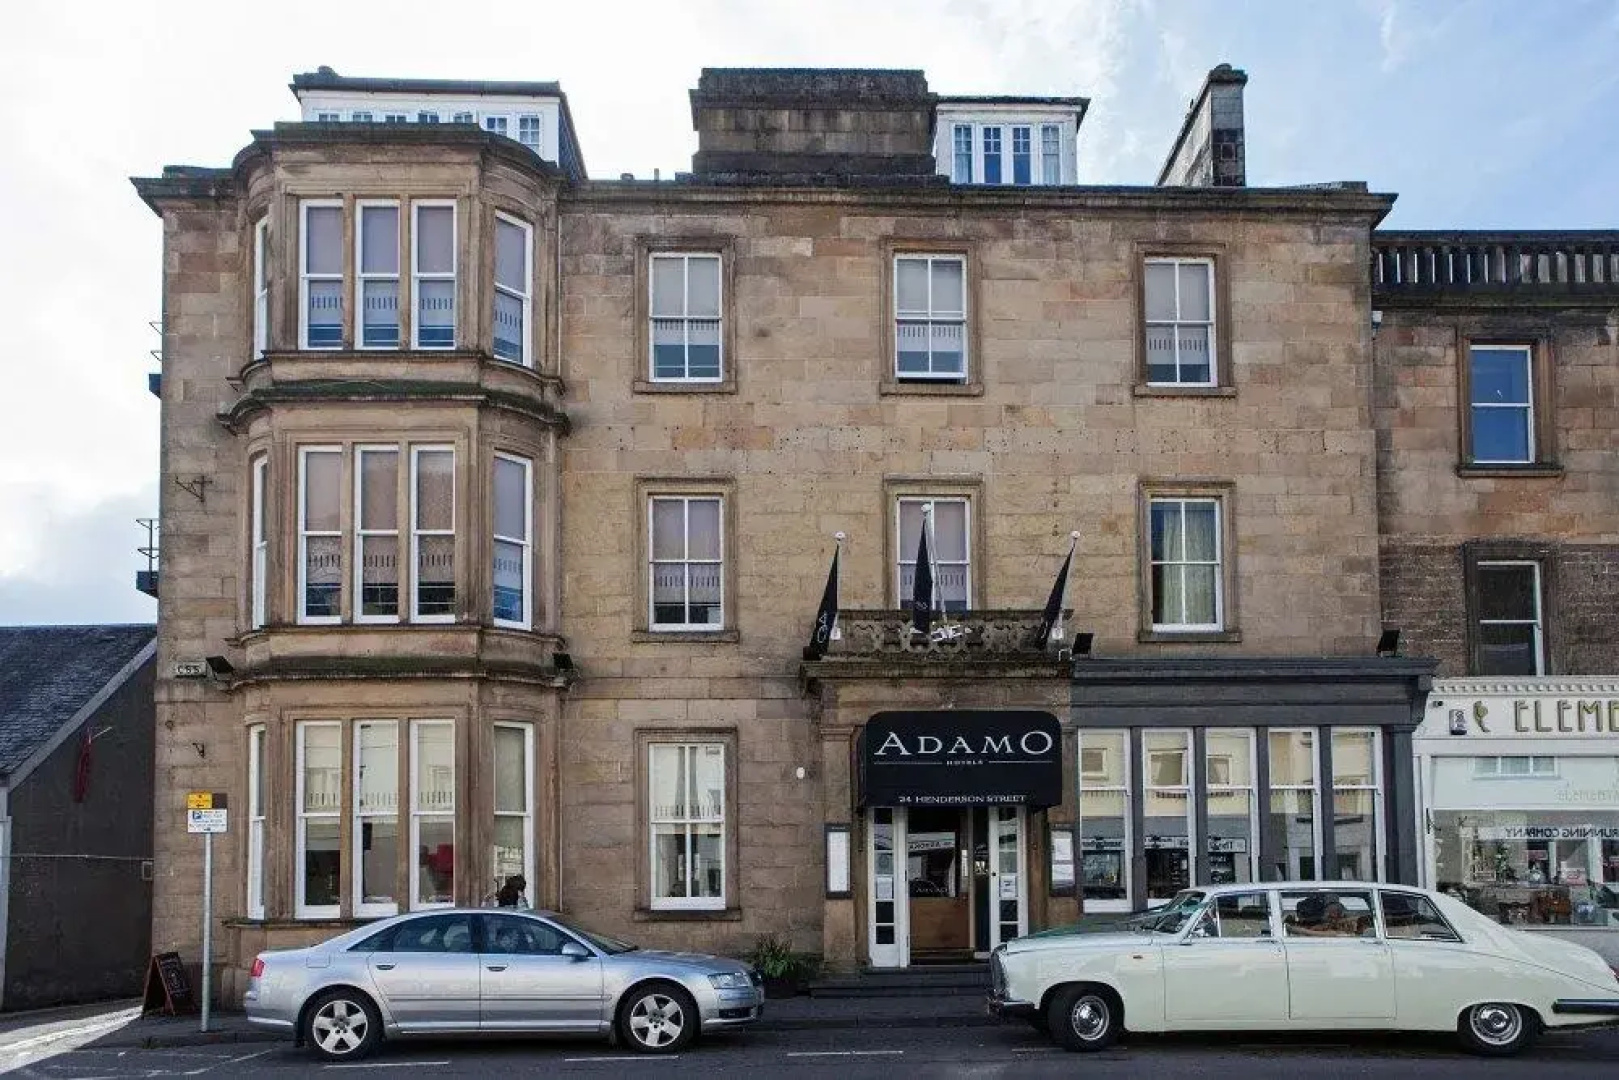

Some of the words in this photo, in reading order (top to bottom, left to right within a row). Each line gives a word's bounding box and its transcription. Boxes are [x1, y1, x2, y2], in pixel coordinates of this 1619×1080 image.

[873, 730, 1053, 756] ADAMO
[915, 796, 984, 804] HENDERSON
[987, 794, 1026, 803] STREET
